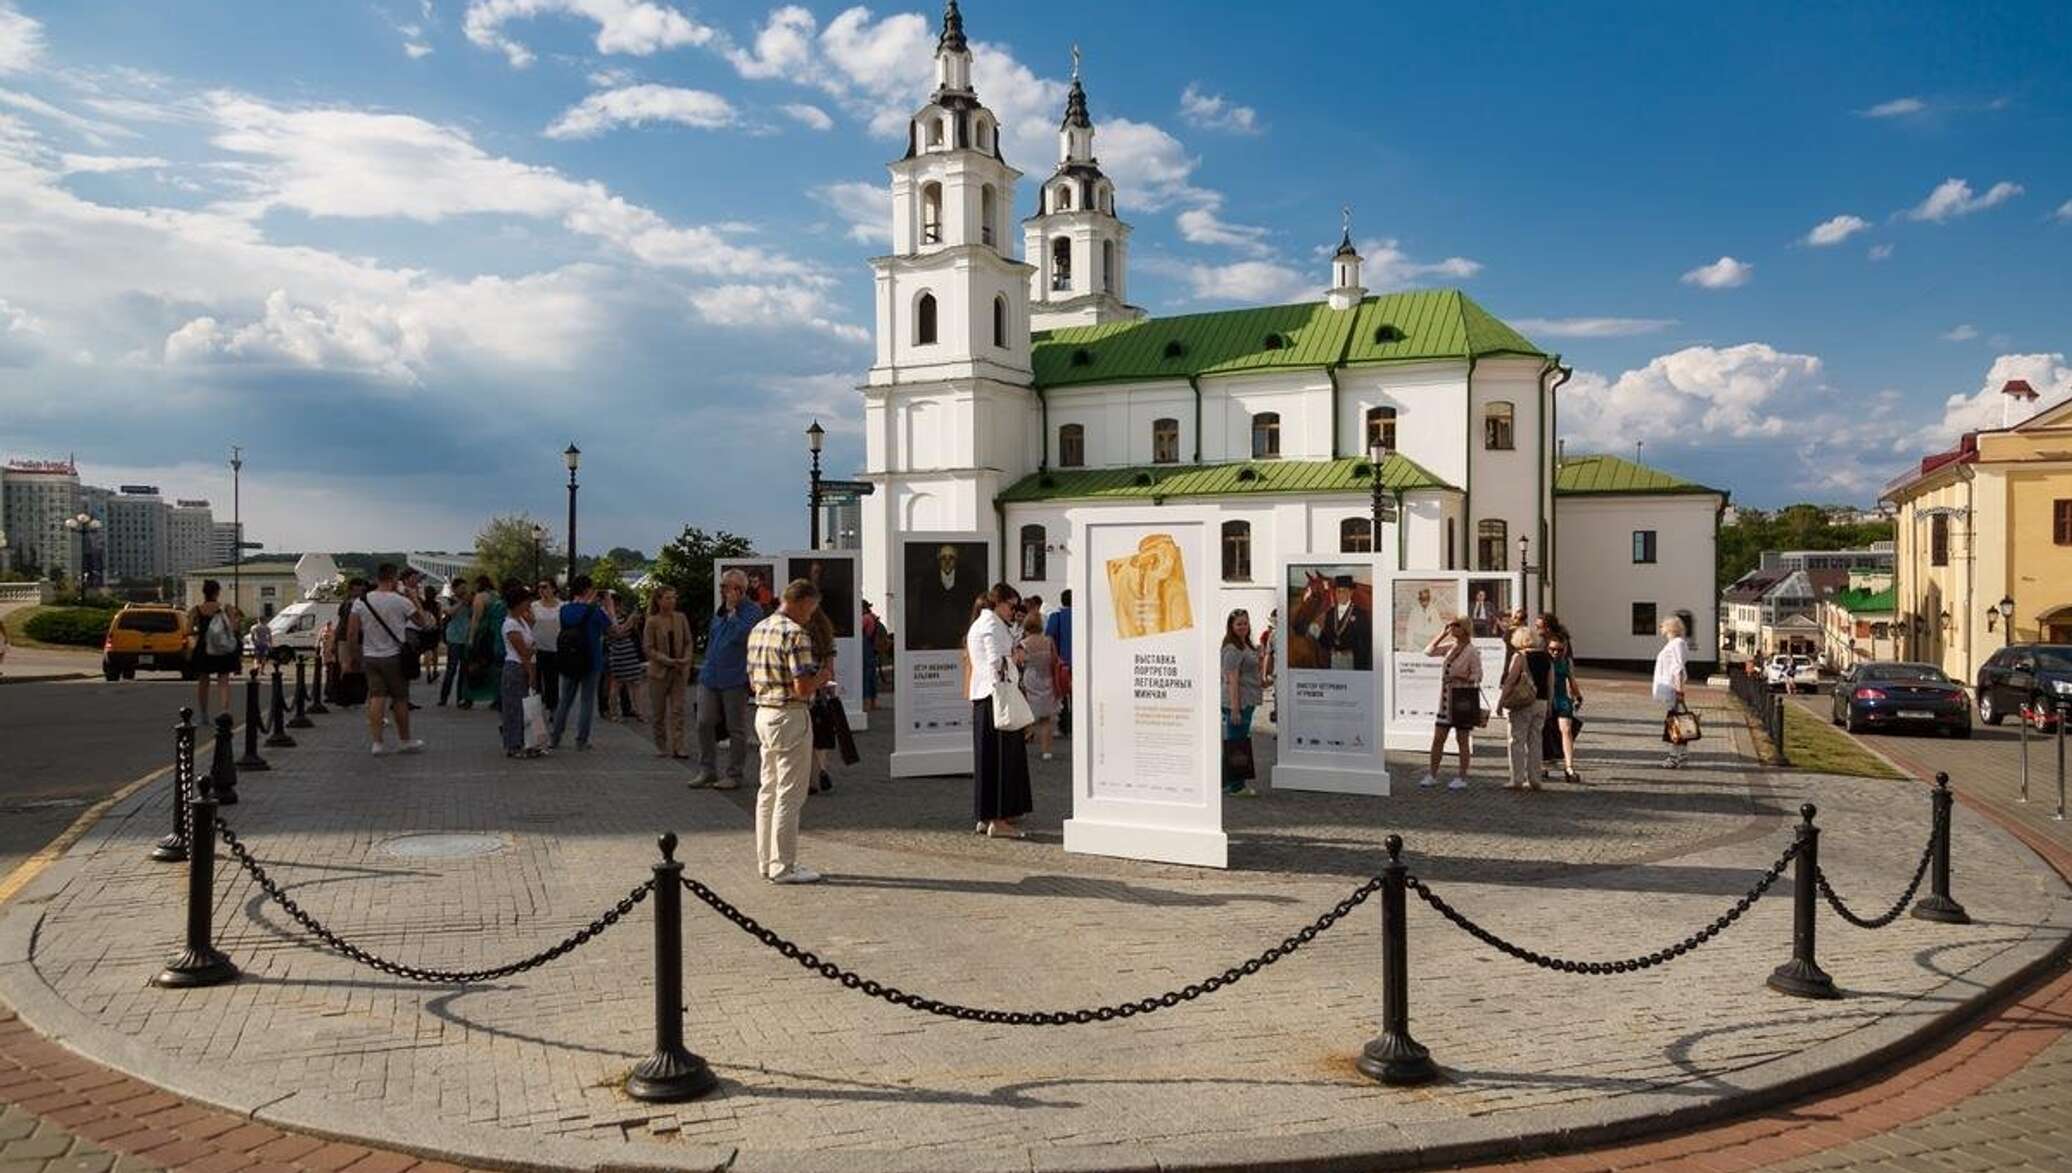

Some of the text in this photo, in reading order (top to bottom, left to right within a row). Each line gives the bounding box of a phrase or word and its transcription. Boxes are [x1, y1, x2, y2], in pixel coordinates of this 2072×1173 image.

[1134, 654, 1176, 664] ВЫСТАВКА
[1134, 665, 1177, 676] ПОРТРЕТОВ
[1134, 677, 1192, 689] ЛЕГЕНДАРНЫХ
[1134, 689, 1167, 699] МИНЧАН
